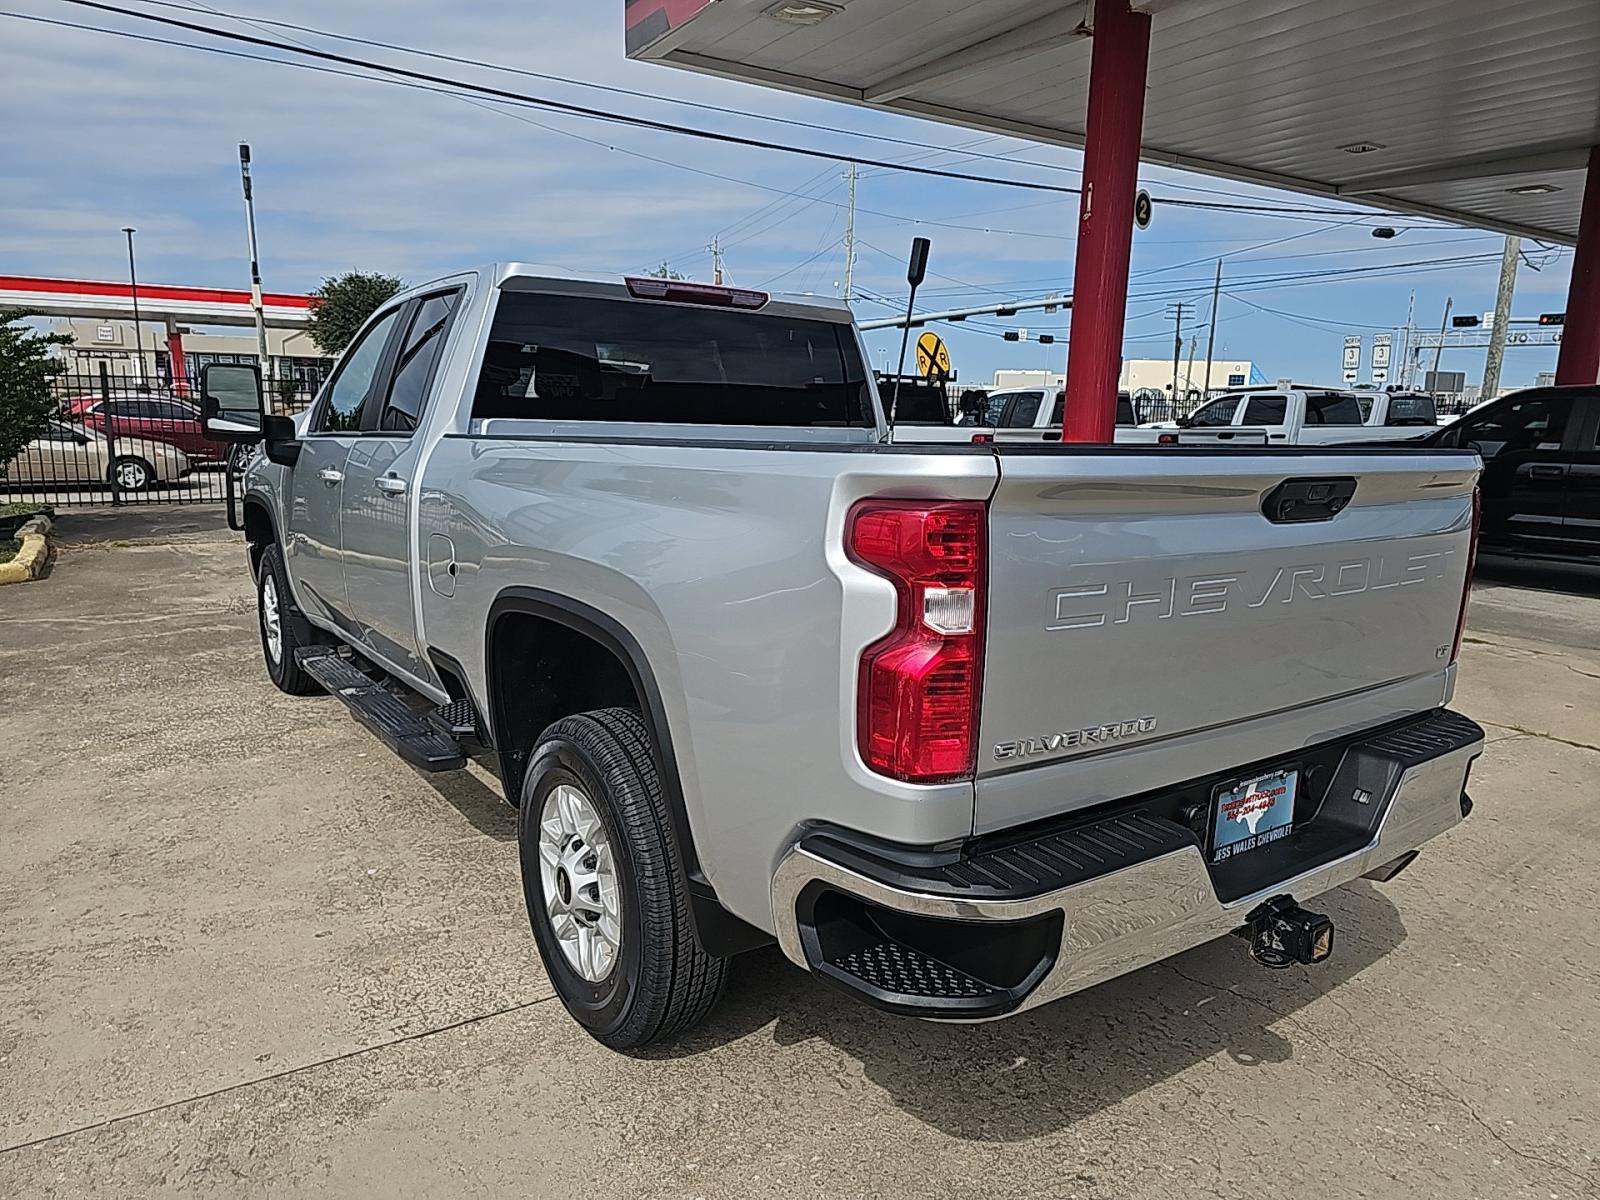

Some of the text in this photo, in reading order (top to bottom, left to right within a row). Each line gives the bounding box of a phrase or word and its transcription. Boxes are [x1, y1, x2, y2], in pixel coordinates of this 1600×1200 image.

[1140, 200, 1147, 219] 2
[919, 352, 948, 368] R R
[1349, 350, 1355, 360] 3
[1379, 348, 1385, 358] 3
[1045, 549, 1455, 631] CHEVROLET
[993, 716, 1158, 761] SILVERADO
[1214, 824, 1293, 861] JESS WALES CHEVROLET
